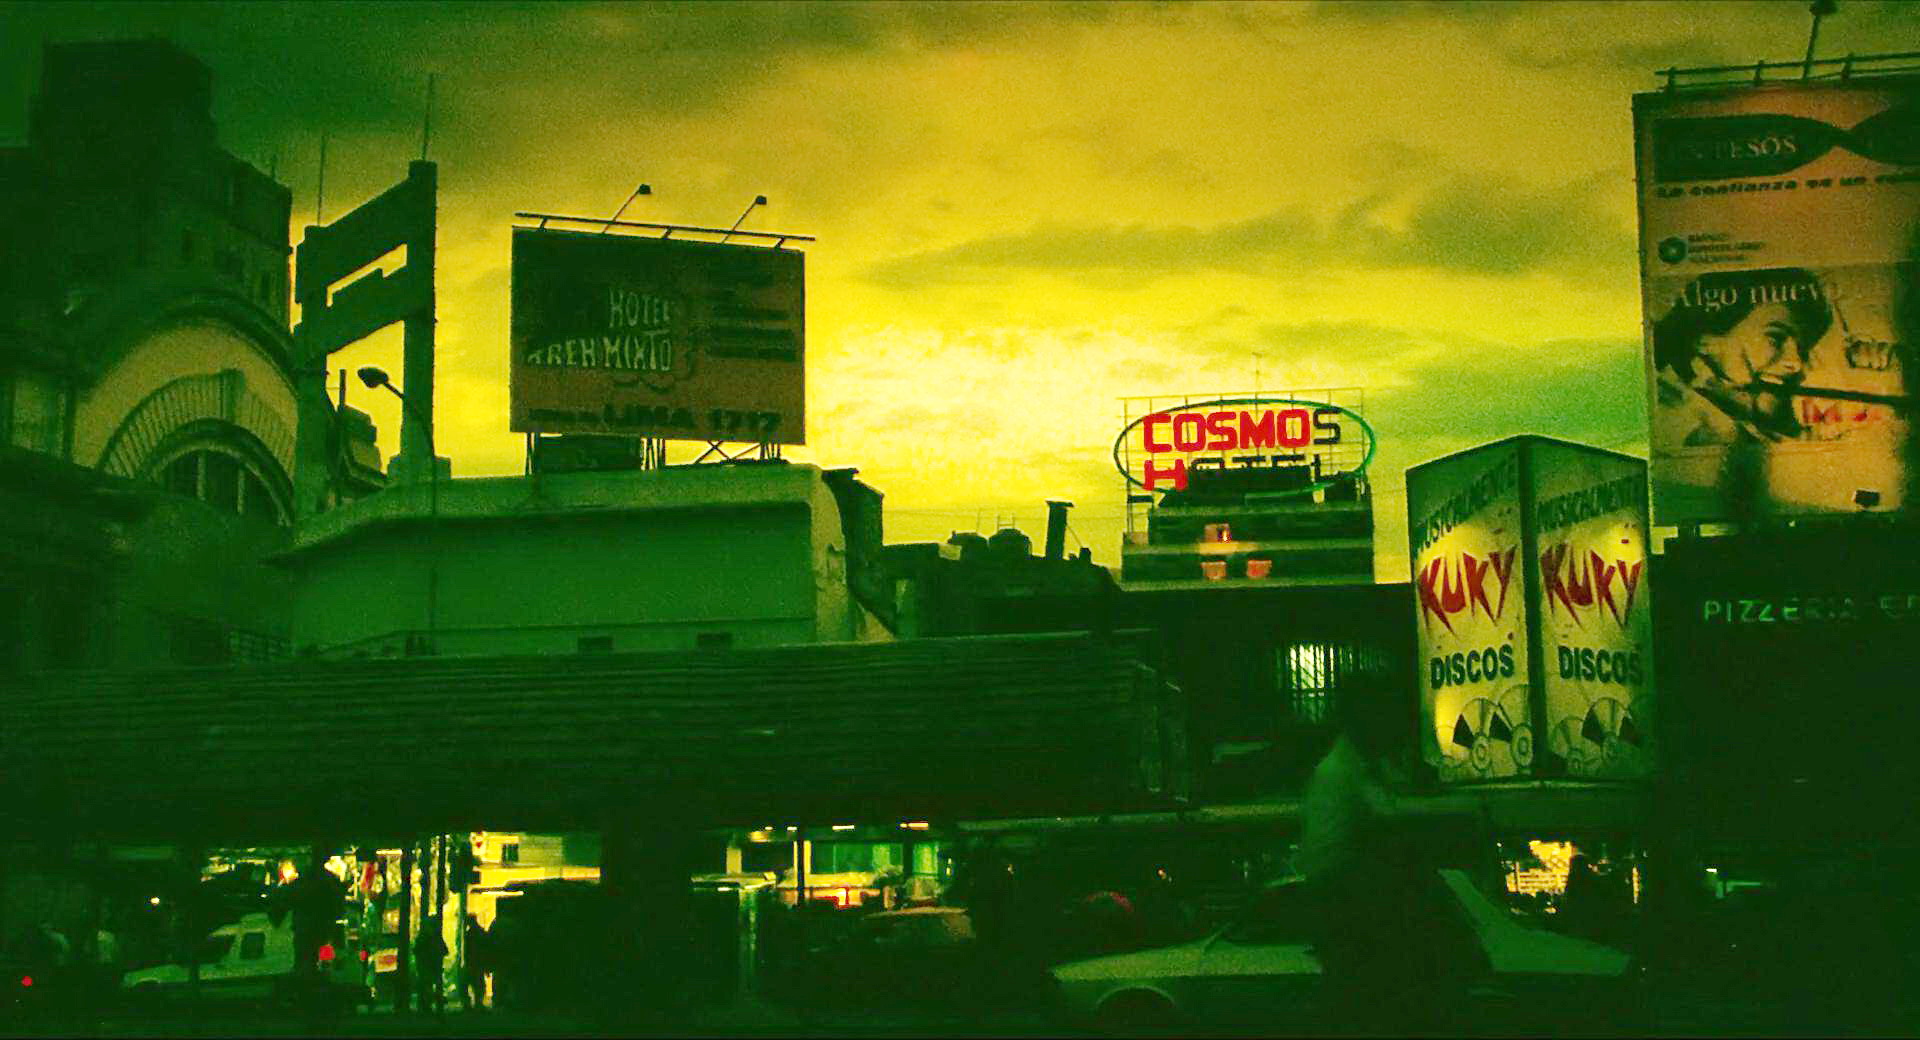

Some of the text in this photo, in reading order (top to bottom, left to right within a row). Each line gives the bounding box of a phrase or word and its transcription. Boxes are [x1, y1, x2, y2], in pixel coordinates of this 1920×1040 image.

[1671, 279, 1738, 313] Algo
[1143, 406, 1342, 453] COSMOS
[1416, 544, 1518, 639] KUKY
[1540, 542, 1643, 631] KUKY
[1429, 643, 1516, 690] DISCOS
[1557, 644, 1642, 684] DISCOS
